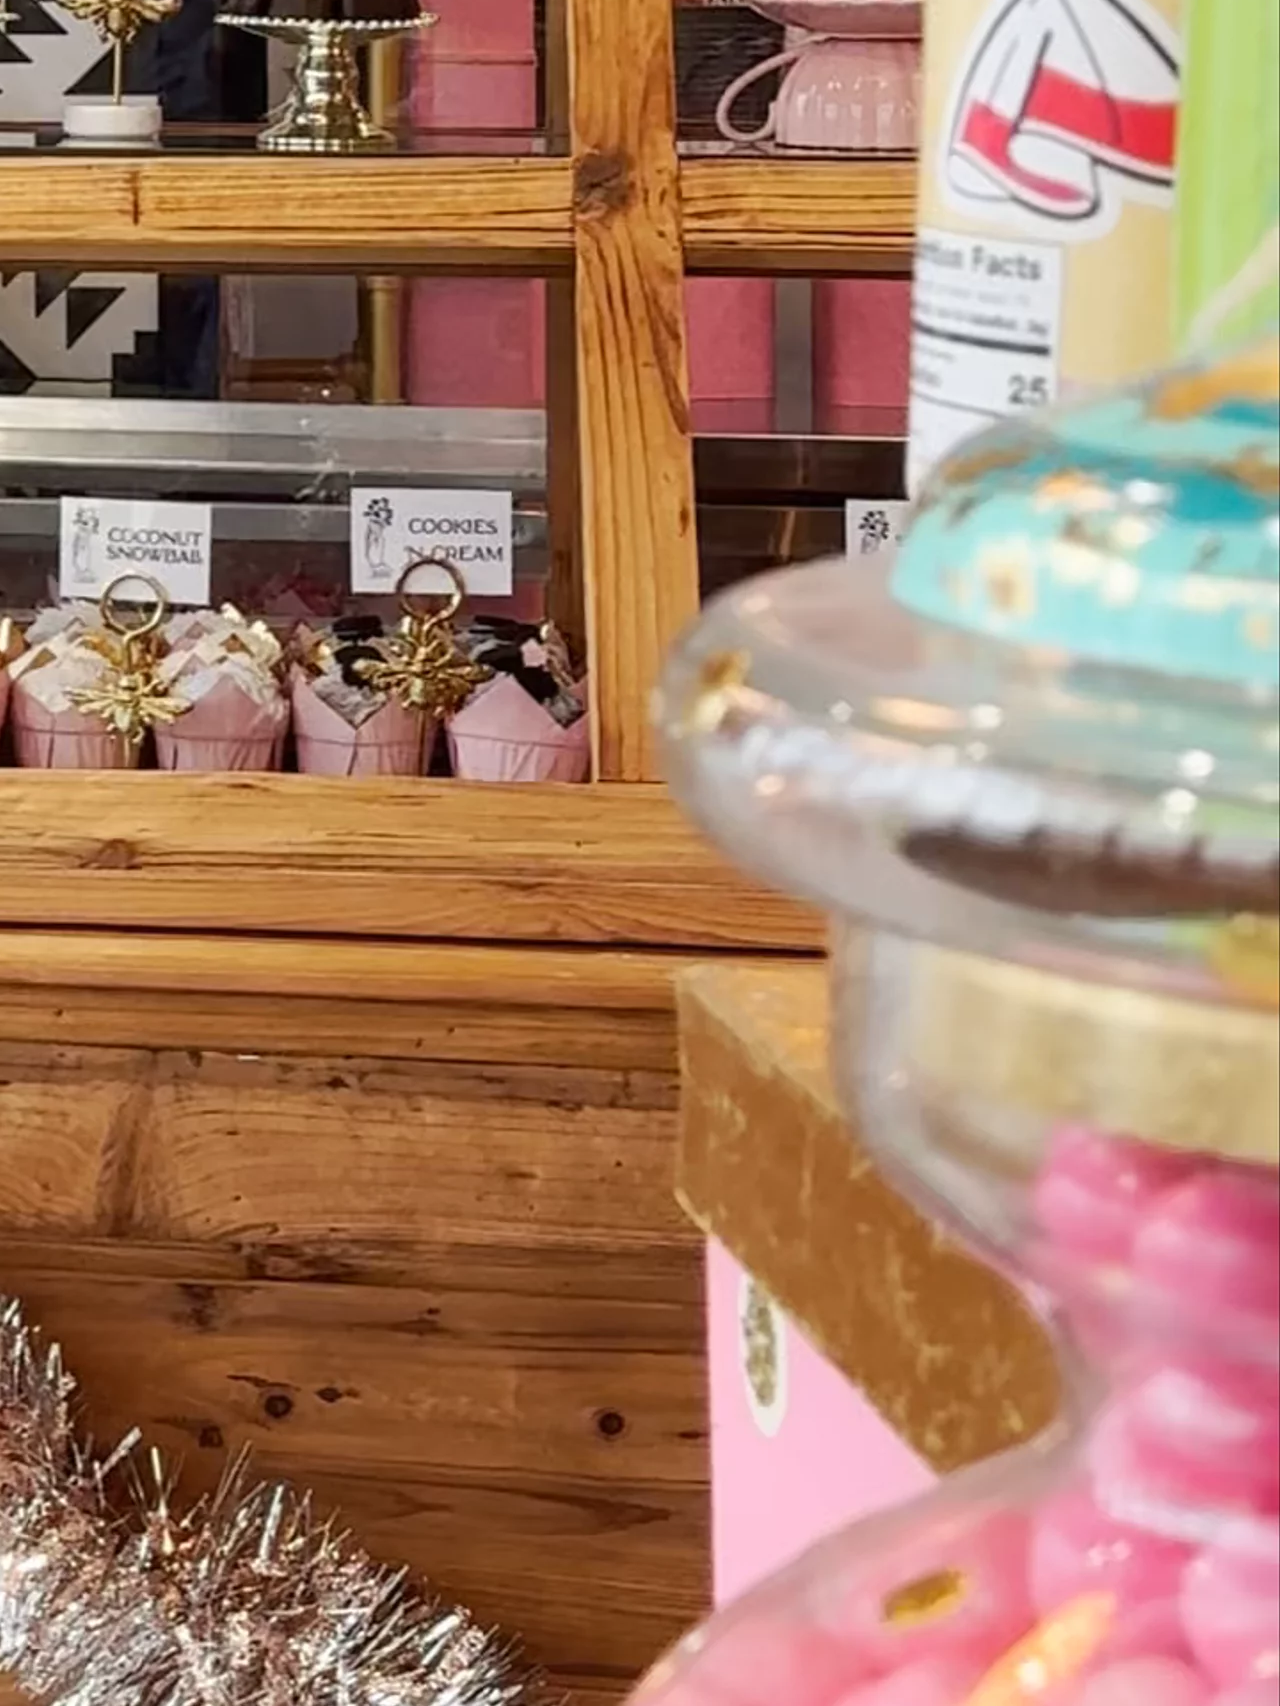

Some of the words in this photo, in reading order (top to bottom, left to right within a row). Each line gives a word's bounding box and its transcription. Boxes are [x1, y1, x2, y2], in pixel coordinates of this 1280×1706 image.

[972, 244, 1042, 281] Facts
[1008, 373, 1048, 406] 25
[107, 526, 204, 546] COCONUT
[408, 518, 498, 535] COOKIES
[431, 544, 504, 563] CREAM
